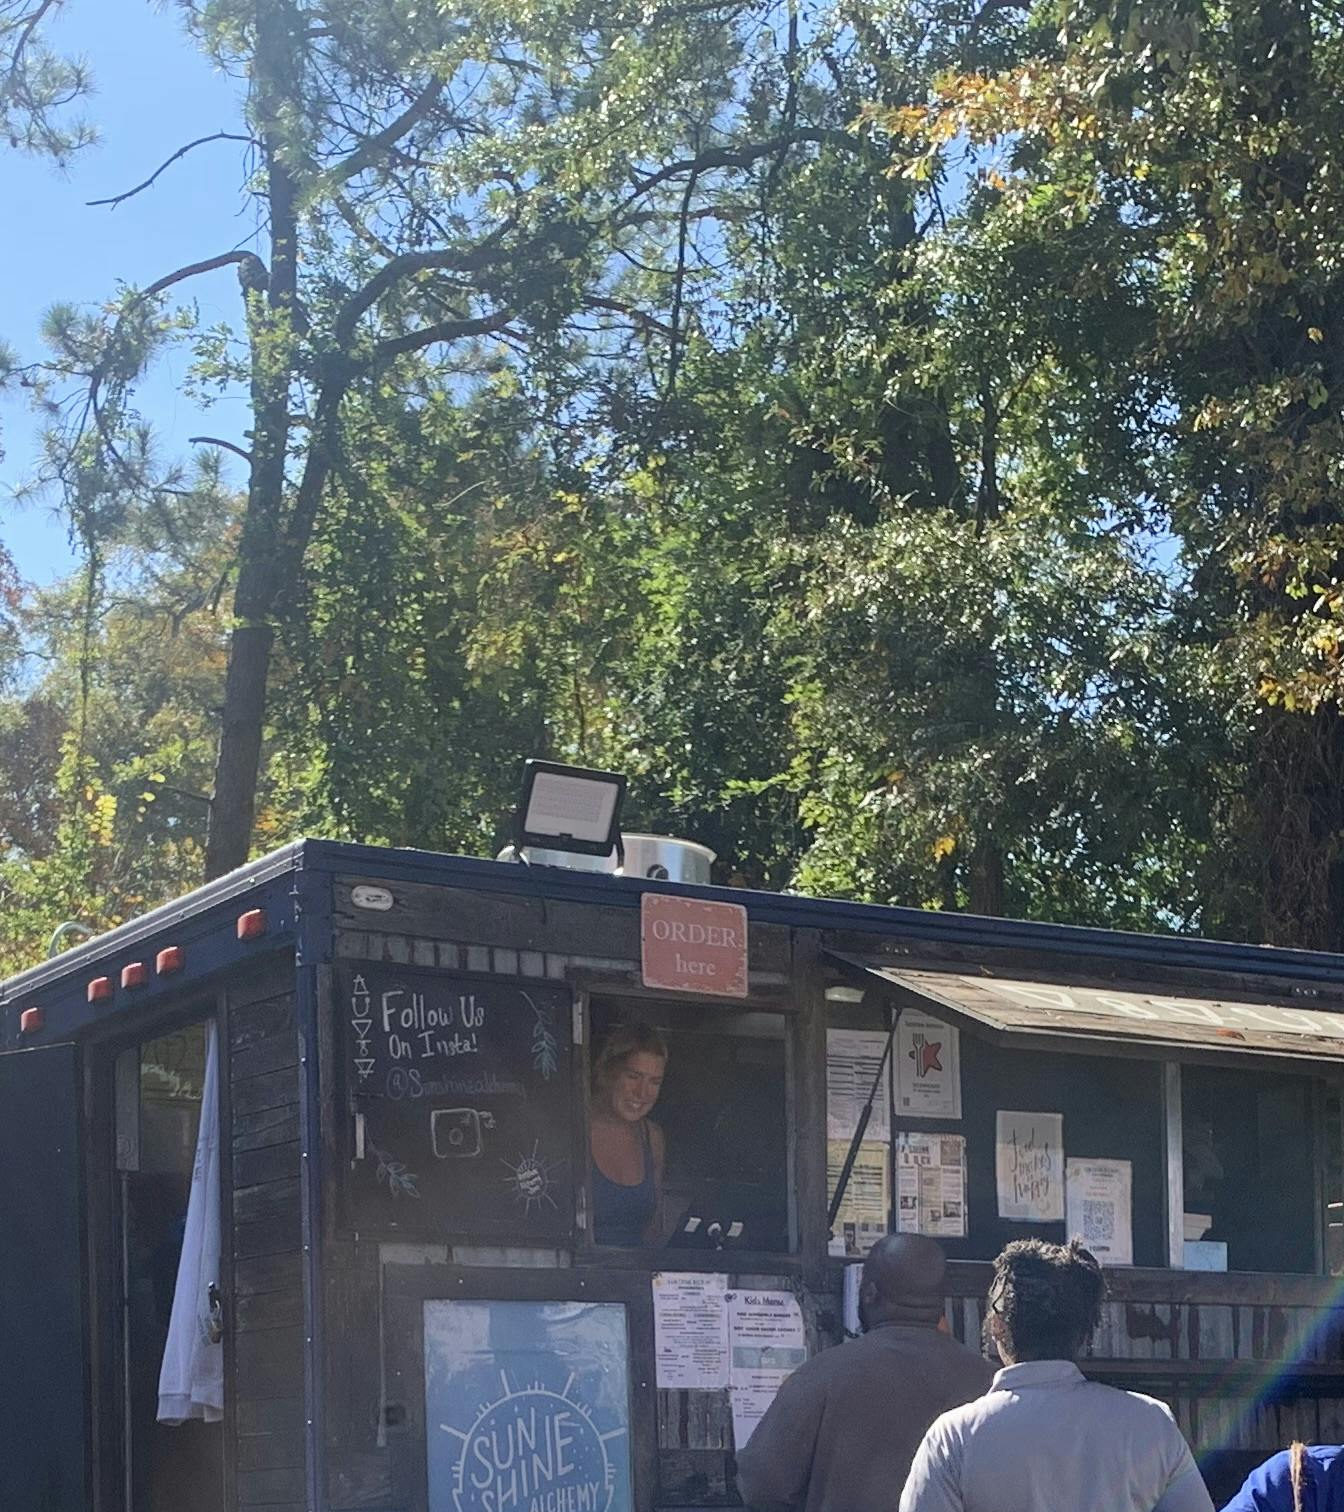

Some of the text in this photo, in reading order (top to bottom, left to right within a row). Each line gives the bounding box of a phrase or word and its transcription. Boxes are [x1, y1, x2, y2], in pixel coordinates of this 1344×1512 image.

[652, 919, 737, 948] ORDER
[675, 953, 716, 976] here
[382, 990, 485, 1032] Follow Us
[389, 1034, 413, 1060] On
[470, 1406, 536, 1489] SUN
